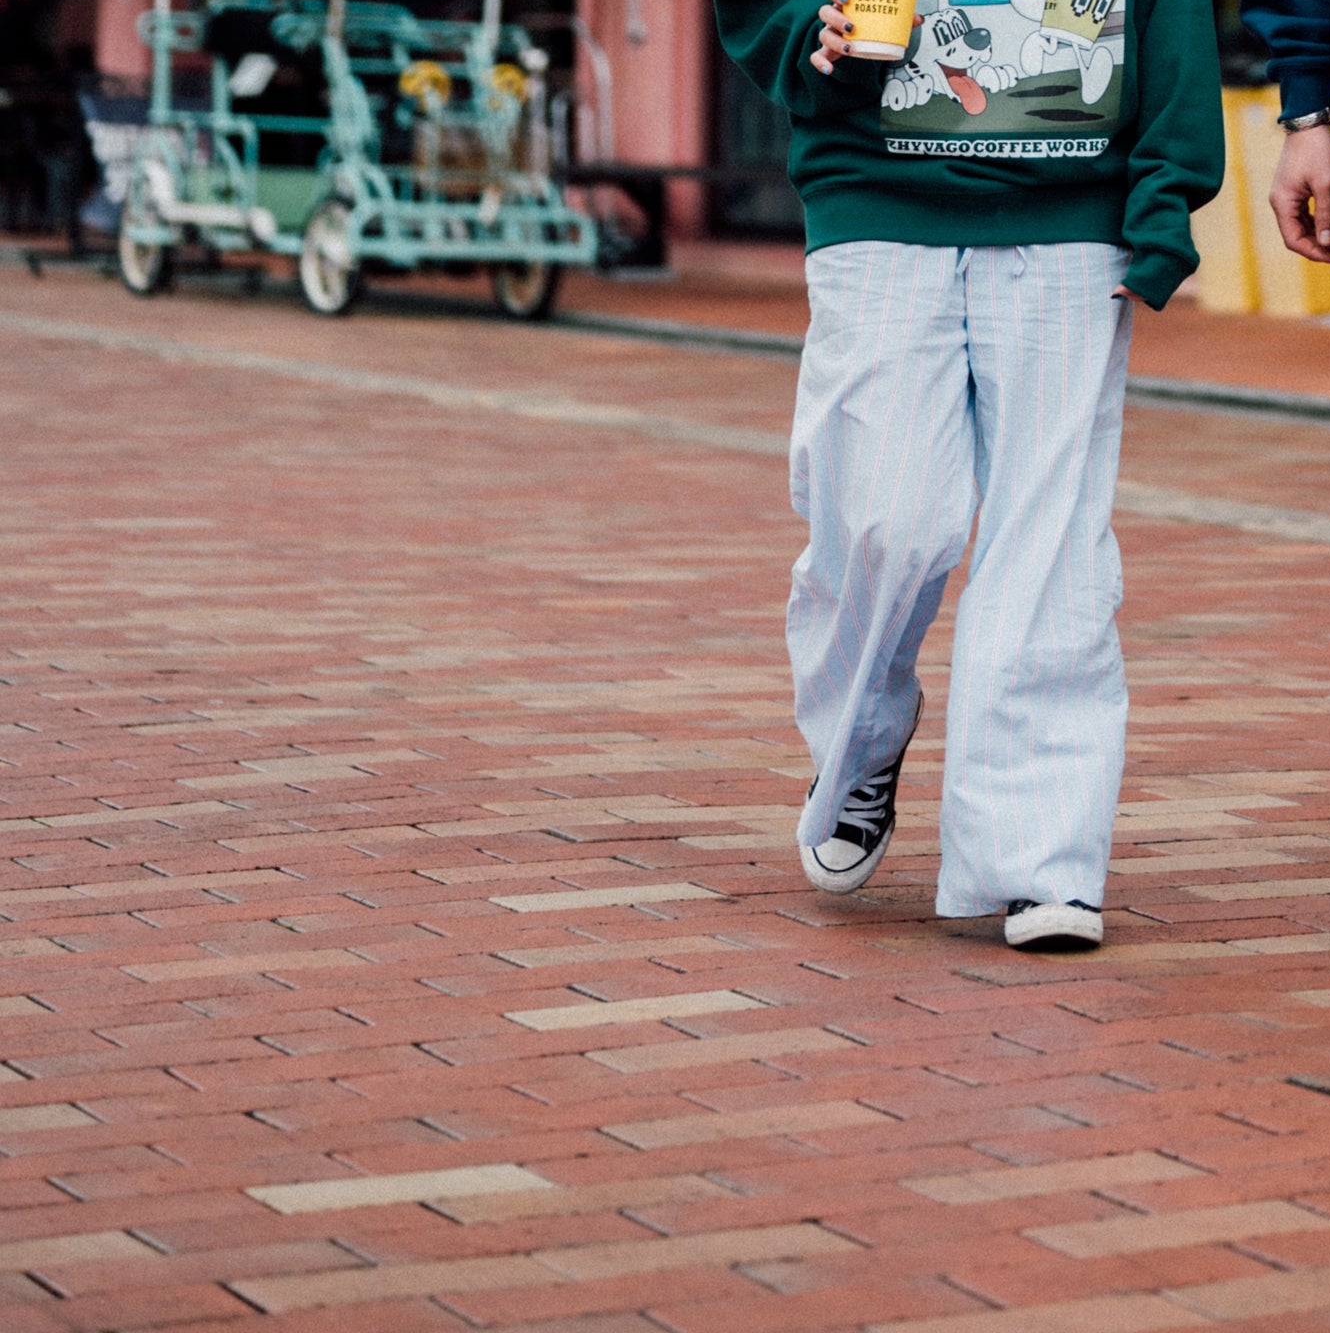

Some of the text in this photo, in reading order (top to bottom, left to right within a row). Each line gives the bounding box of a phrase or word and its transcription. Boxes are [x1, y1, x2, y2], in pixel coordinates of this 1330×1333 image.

[855, 3, 899, 15] ROASTERY
[974, 139, 1043, 153] COFFEE
[1047, 139, 1108, 153] WORKS
